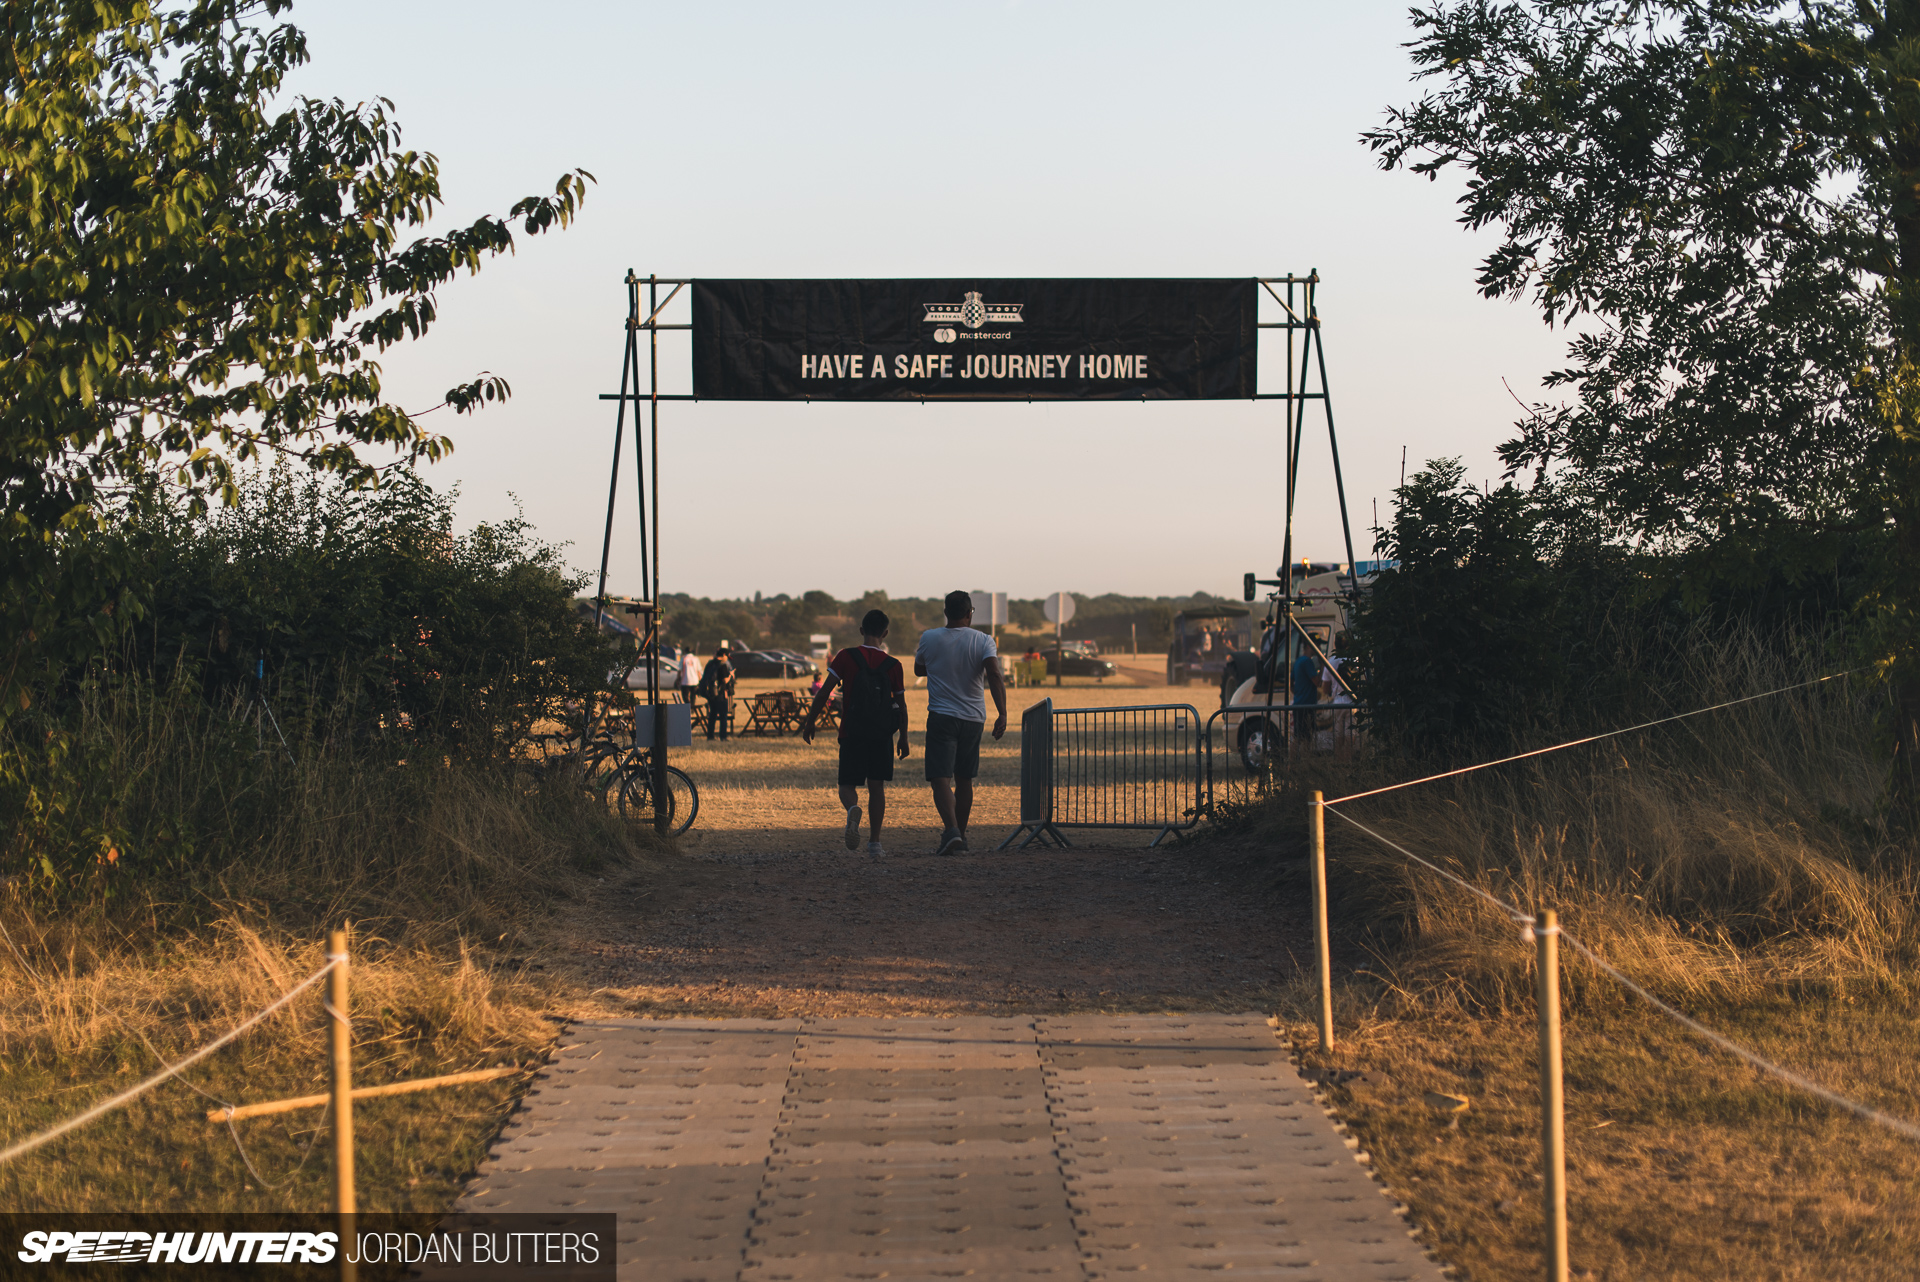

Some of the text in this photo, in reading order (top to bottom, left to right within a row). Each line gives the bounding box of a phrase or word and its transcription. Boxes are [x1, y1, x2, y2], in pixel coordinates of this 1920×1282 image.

[959, 331, 1011, 339] mastercard
[801, 354, 1148, 379] HAVE A SAFE JOURNEY HOME
[1367, 561, 1386, 571] ICE
